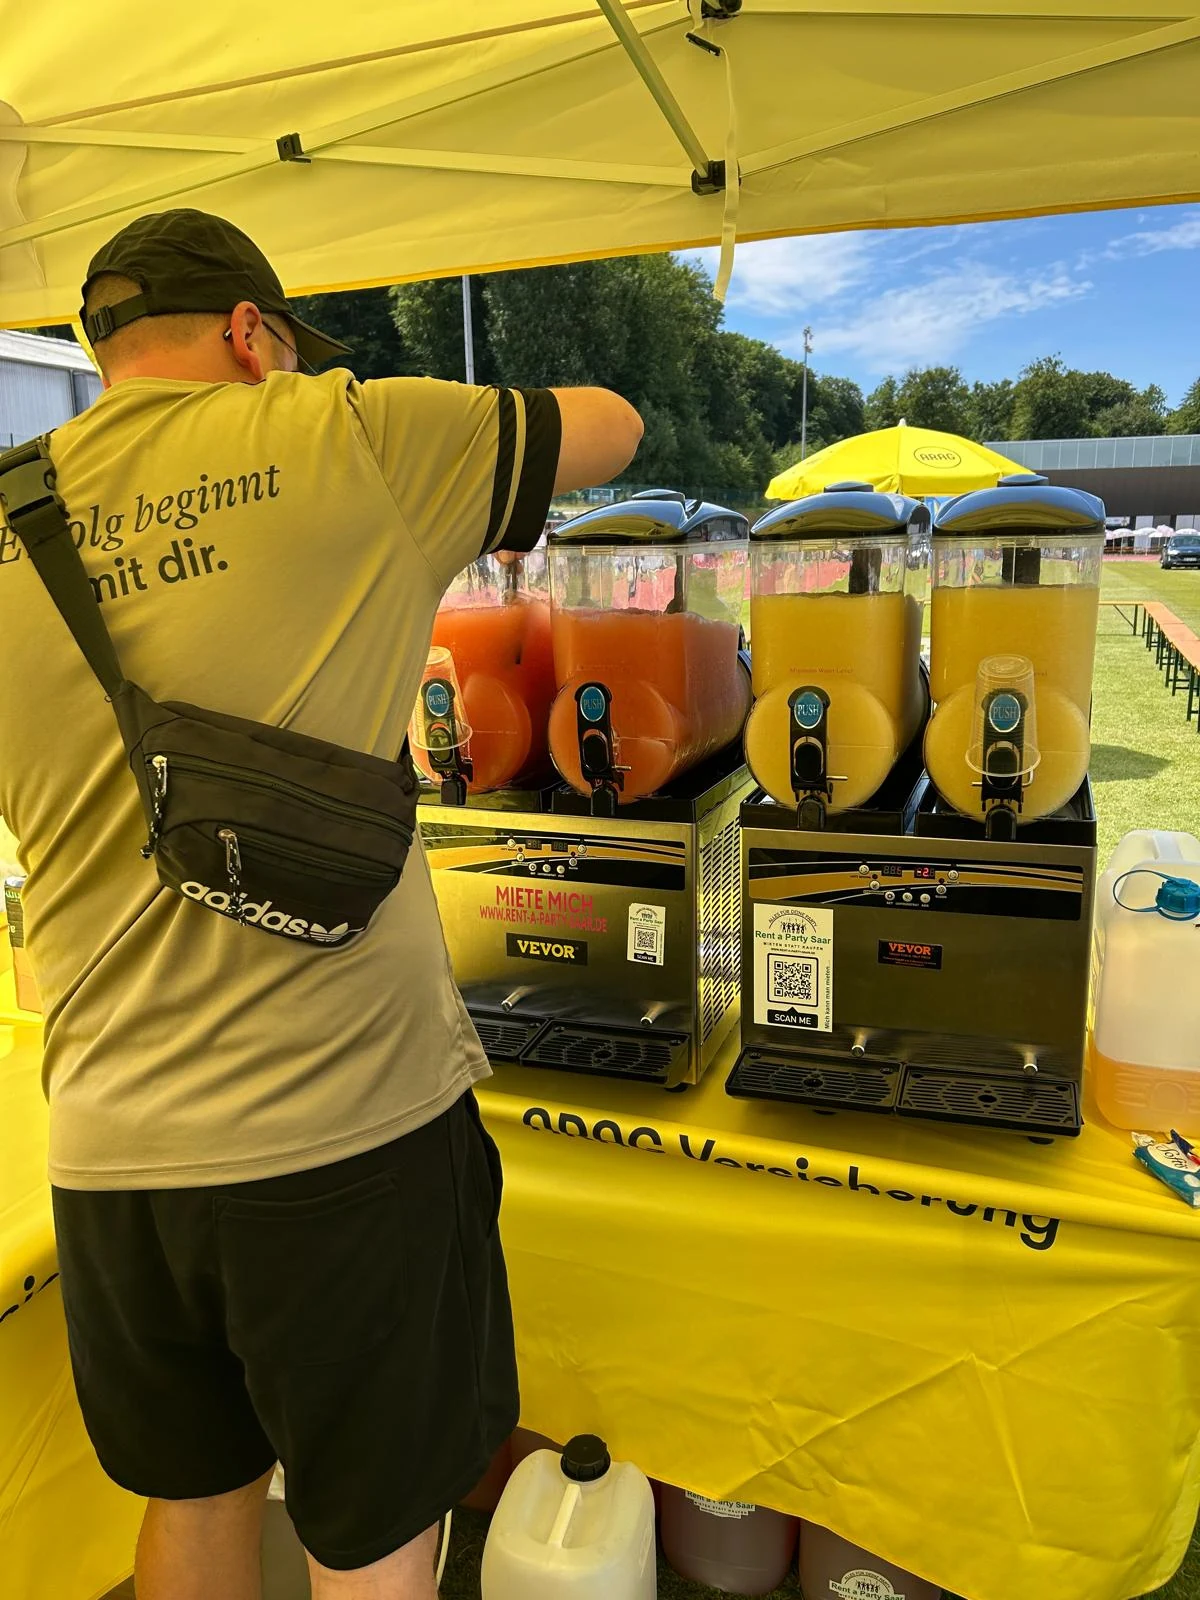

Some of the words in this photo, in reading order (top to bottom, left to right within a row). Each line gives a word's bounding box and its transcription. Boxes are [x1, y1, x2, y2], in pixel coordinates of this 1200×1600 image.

[919, 453, 956, 462] ARAG
[0, 505, 125, 565] Eolg
[134, 465, 280, 530] beginnt
[88, 556, 148, 603] mit
[158, 537, 228, 584] dir.
[428, 693, 448, 705] PUSH
[583, 698, 603, 710] PUSH
[797, 704, 819, 715] PUSH
[992, 706, 1017, 719] PUSH
[496, 885, 544, 910] MIETE
[547, 890, 594, 915] MICH
[755, 930, 775, 939] Rent
[785, 933, 808, 944] Party
[810, 935, 832, 944] Saar
[517, 940, 575, 959] VEVOR
[888, 942, 931, 955] VEVOR
[774, 1013, 797, 1023] SCAN
[798, 1016, 812, 1025] ME
[736, 1501, 754, 1509] Saar
[831, 1582, 850, 1593] Rent
[860, 1590, 882, 1600] Party
